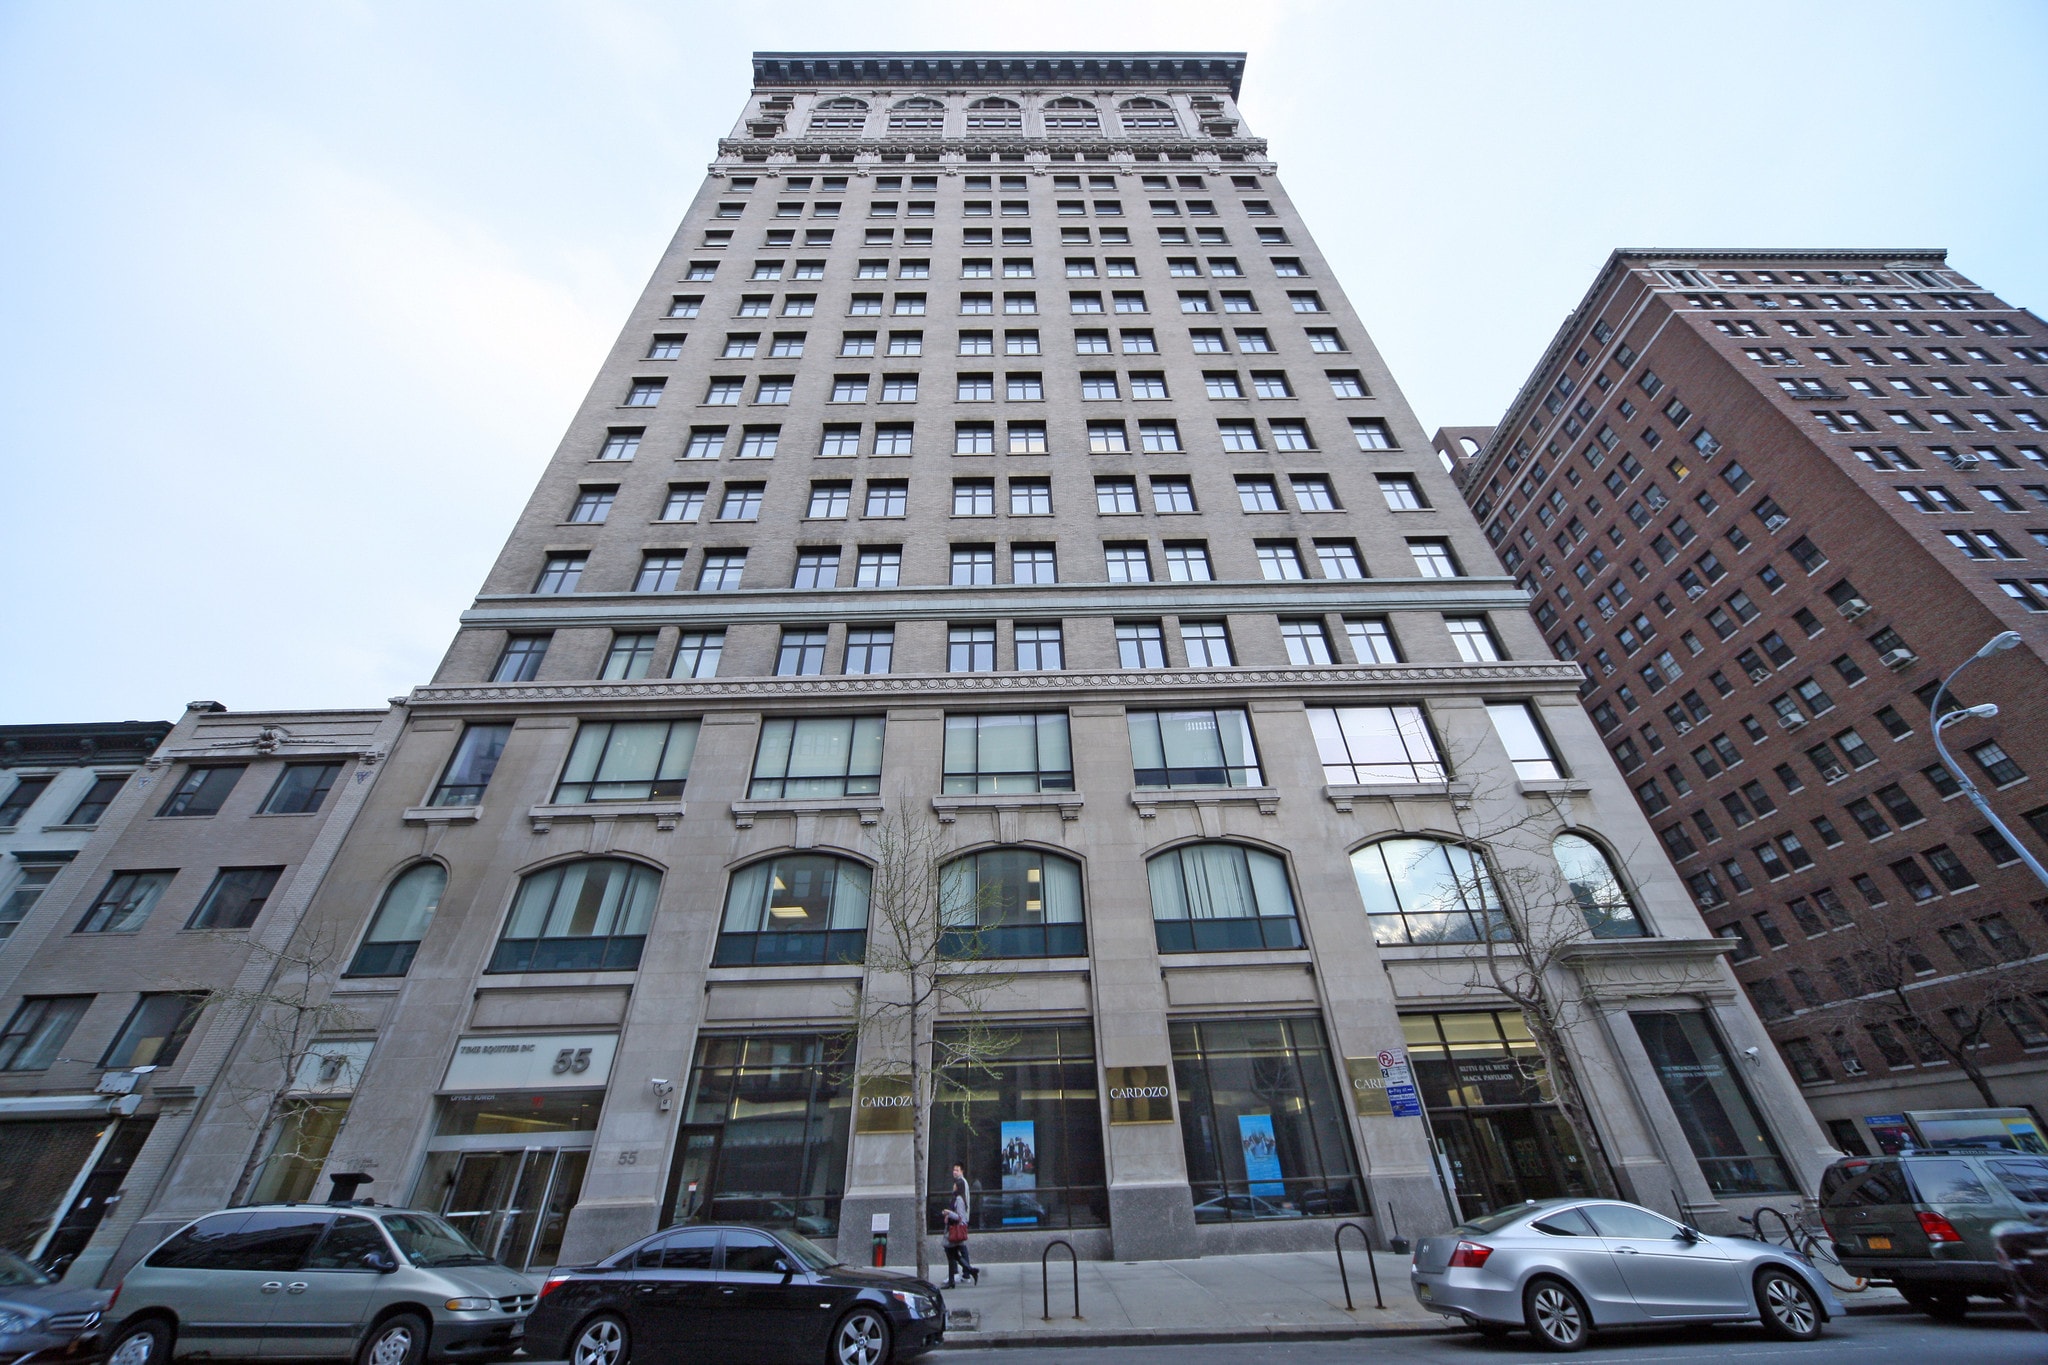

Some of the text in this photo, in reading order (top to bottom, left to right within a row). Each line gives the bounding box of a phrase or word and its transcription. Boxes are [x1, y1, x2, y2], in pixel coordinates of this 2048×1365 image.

[460, 1044, 536, 1054] TIME EQUITIES INC
[552, 1048, 593, 1075] 55
[1483, 1073, 1514, 1081] PAVILION
[1110, 1086, 1169, 1099] CARDOZO
[618, 1151, 638, 1165] 55
